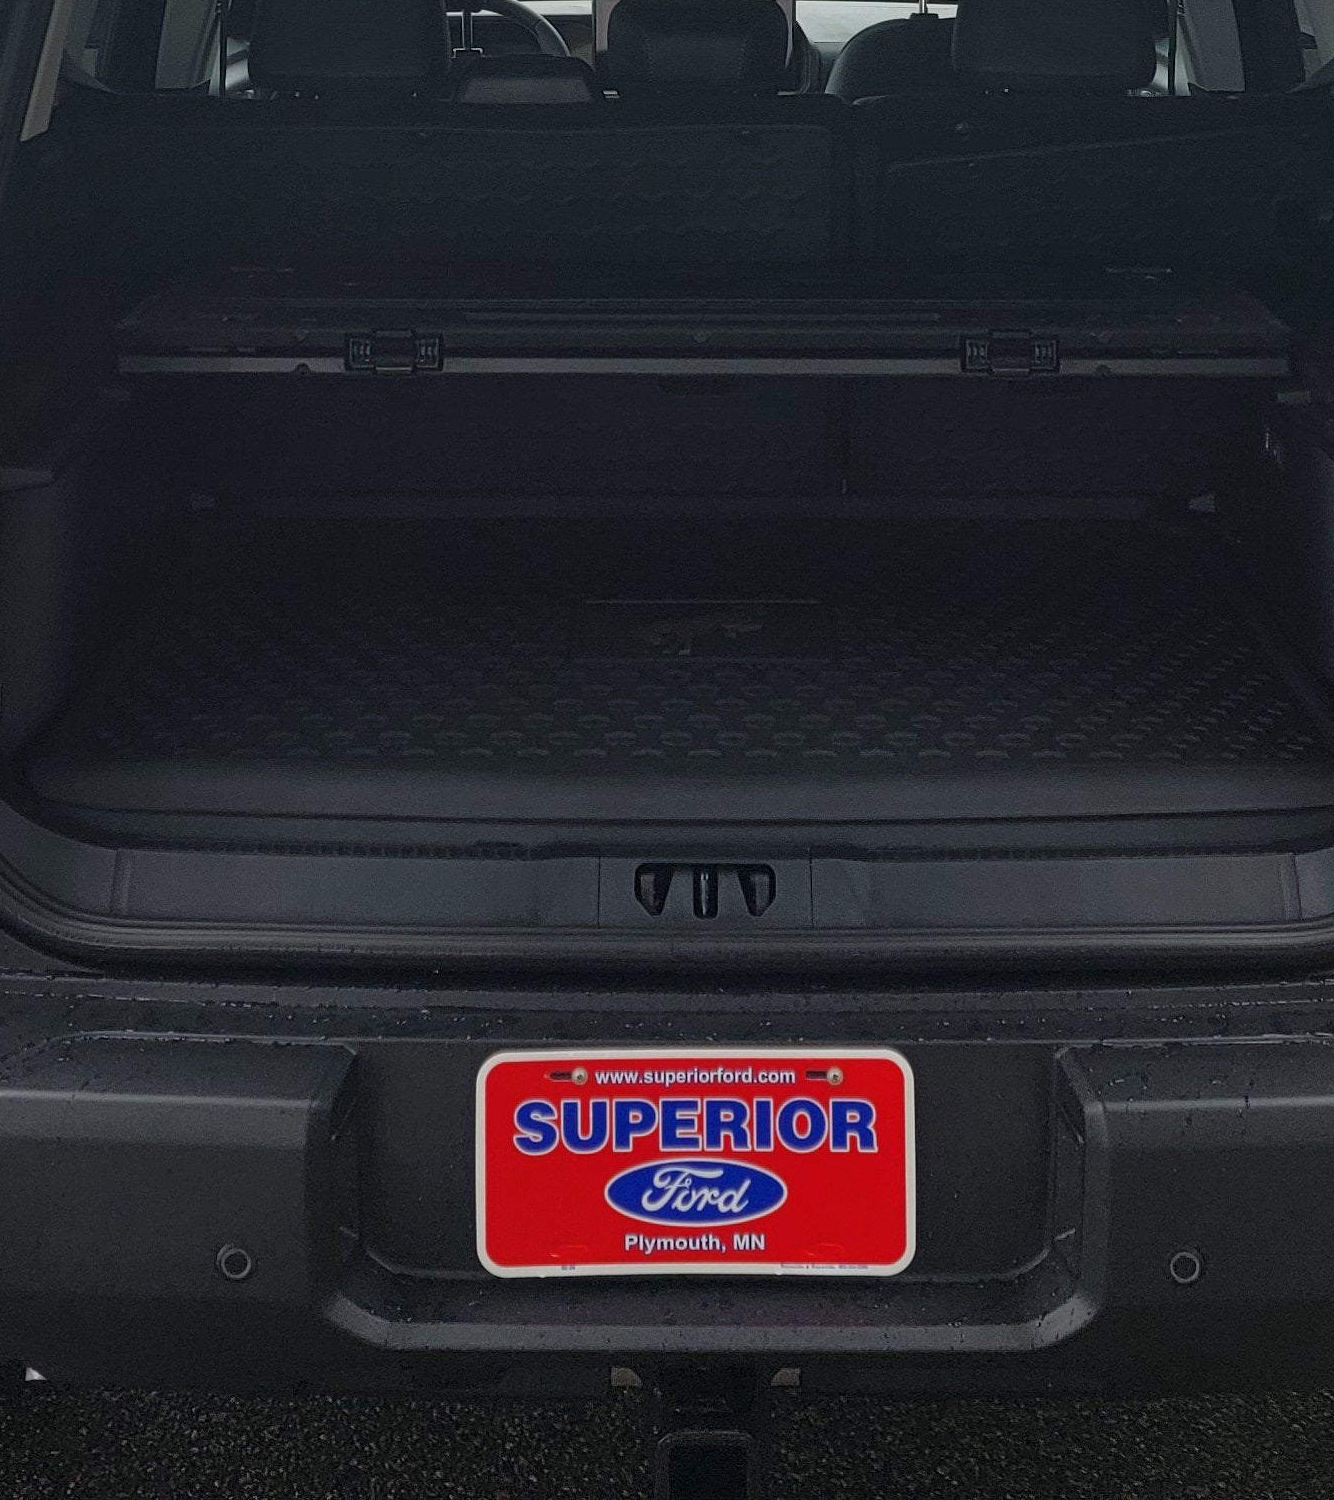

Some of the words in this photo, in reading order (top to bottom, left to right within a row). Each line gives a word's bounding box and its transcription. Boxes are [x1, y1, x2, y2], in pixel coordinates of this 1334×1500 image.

[595, 1067, 796, 1086] www.superiorford.com
[513, 1098, 879, 1156] SUPERIOR
[641, 1164, 752, 1214] Ford
[624, 1233, 727, 1255] Plymouth,
[733, 1234, 766, 1251] MN
